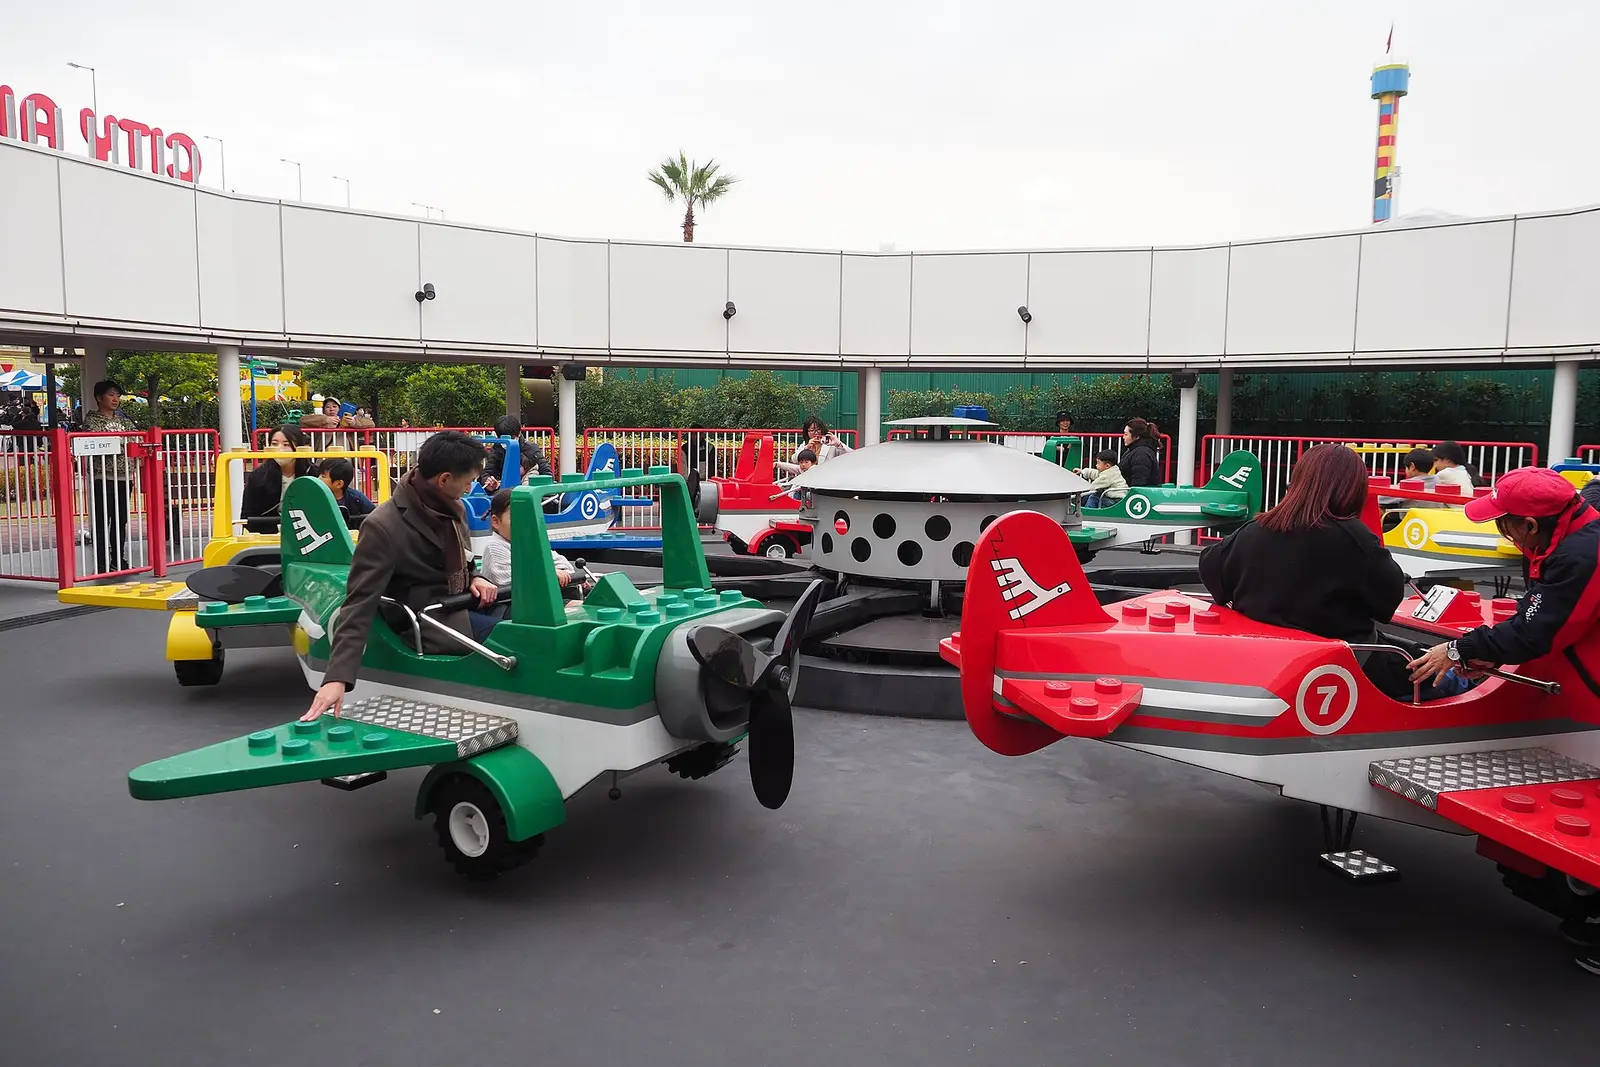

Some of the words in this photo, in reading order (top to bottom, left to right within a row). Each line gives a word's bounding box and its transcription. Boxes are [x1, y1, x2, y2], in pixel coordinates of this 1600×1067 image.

[586, 500, 594, 513] 2
[1132, 501, 1143, 513] 4
[1411, 527, 1420, 541] 5
[1317, 685, 1338, 715] 7
